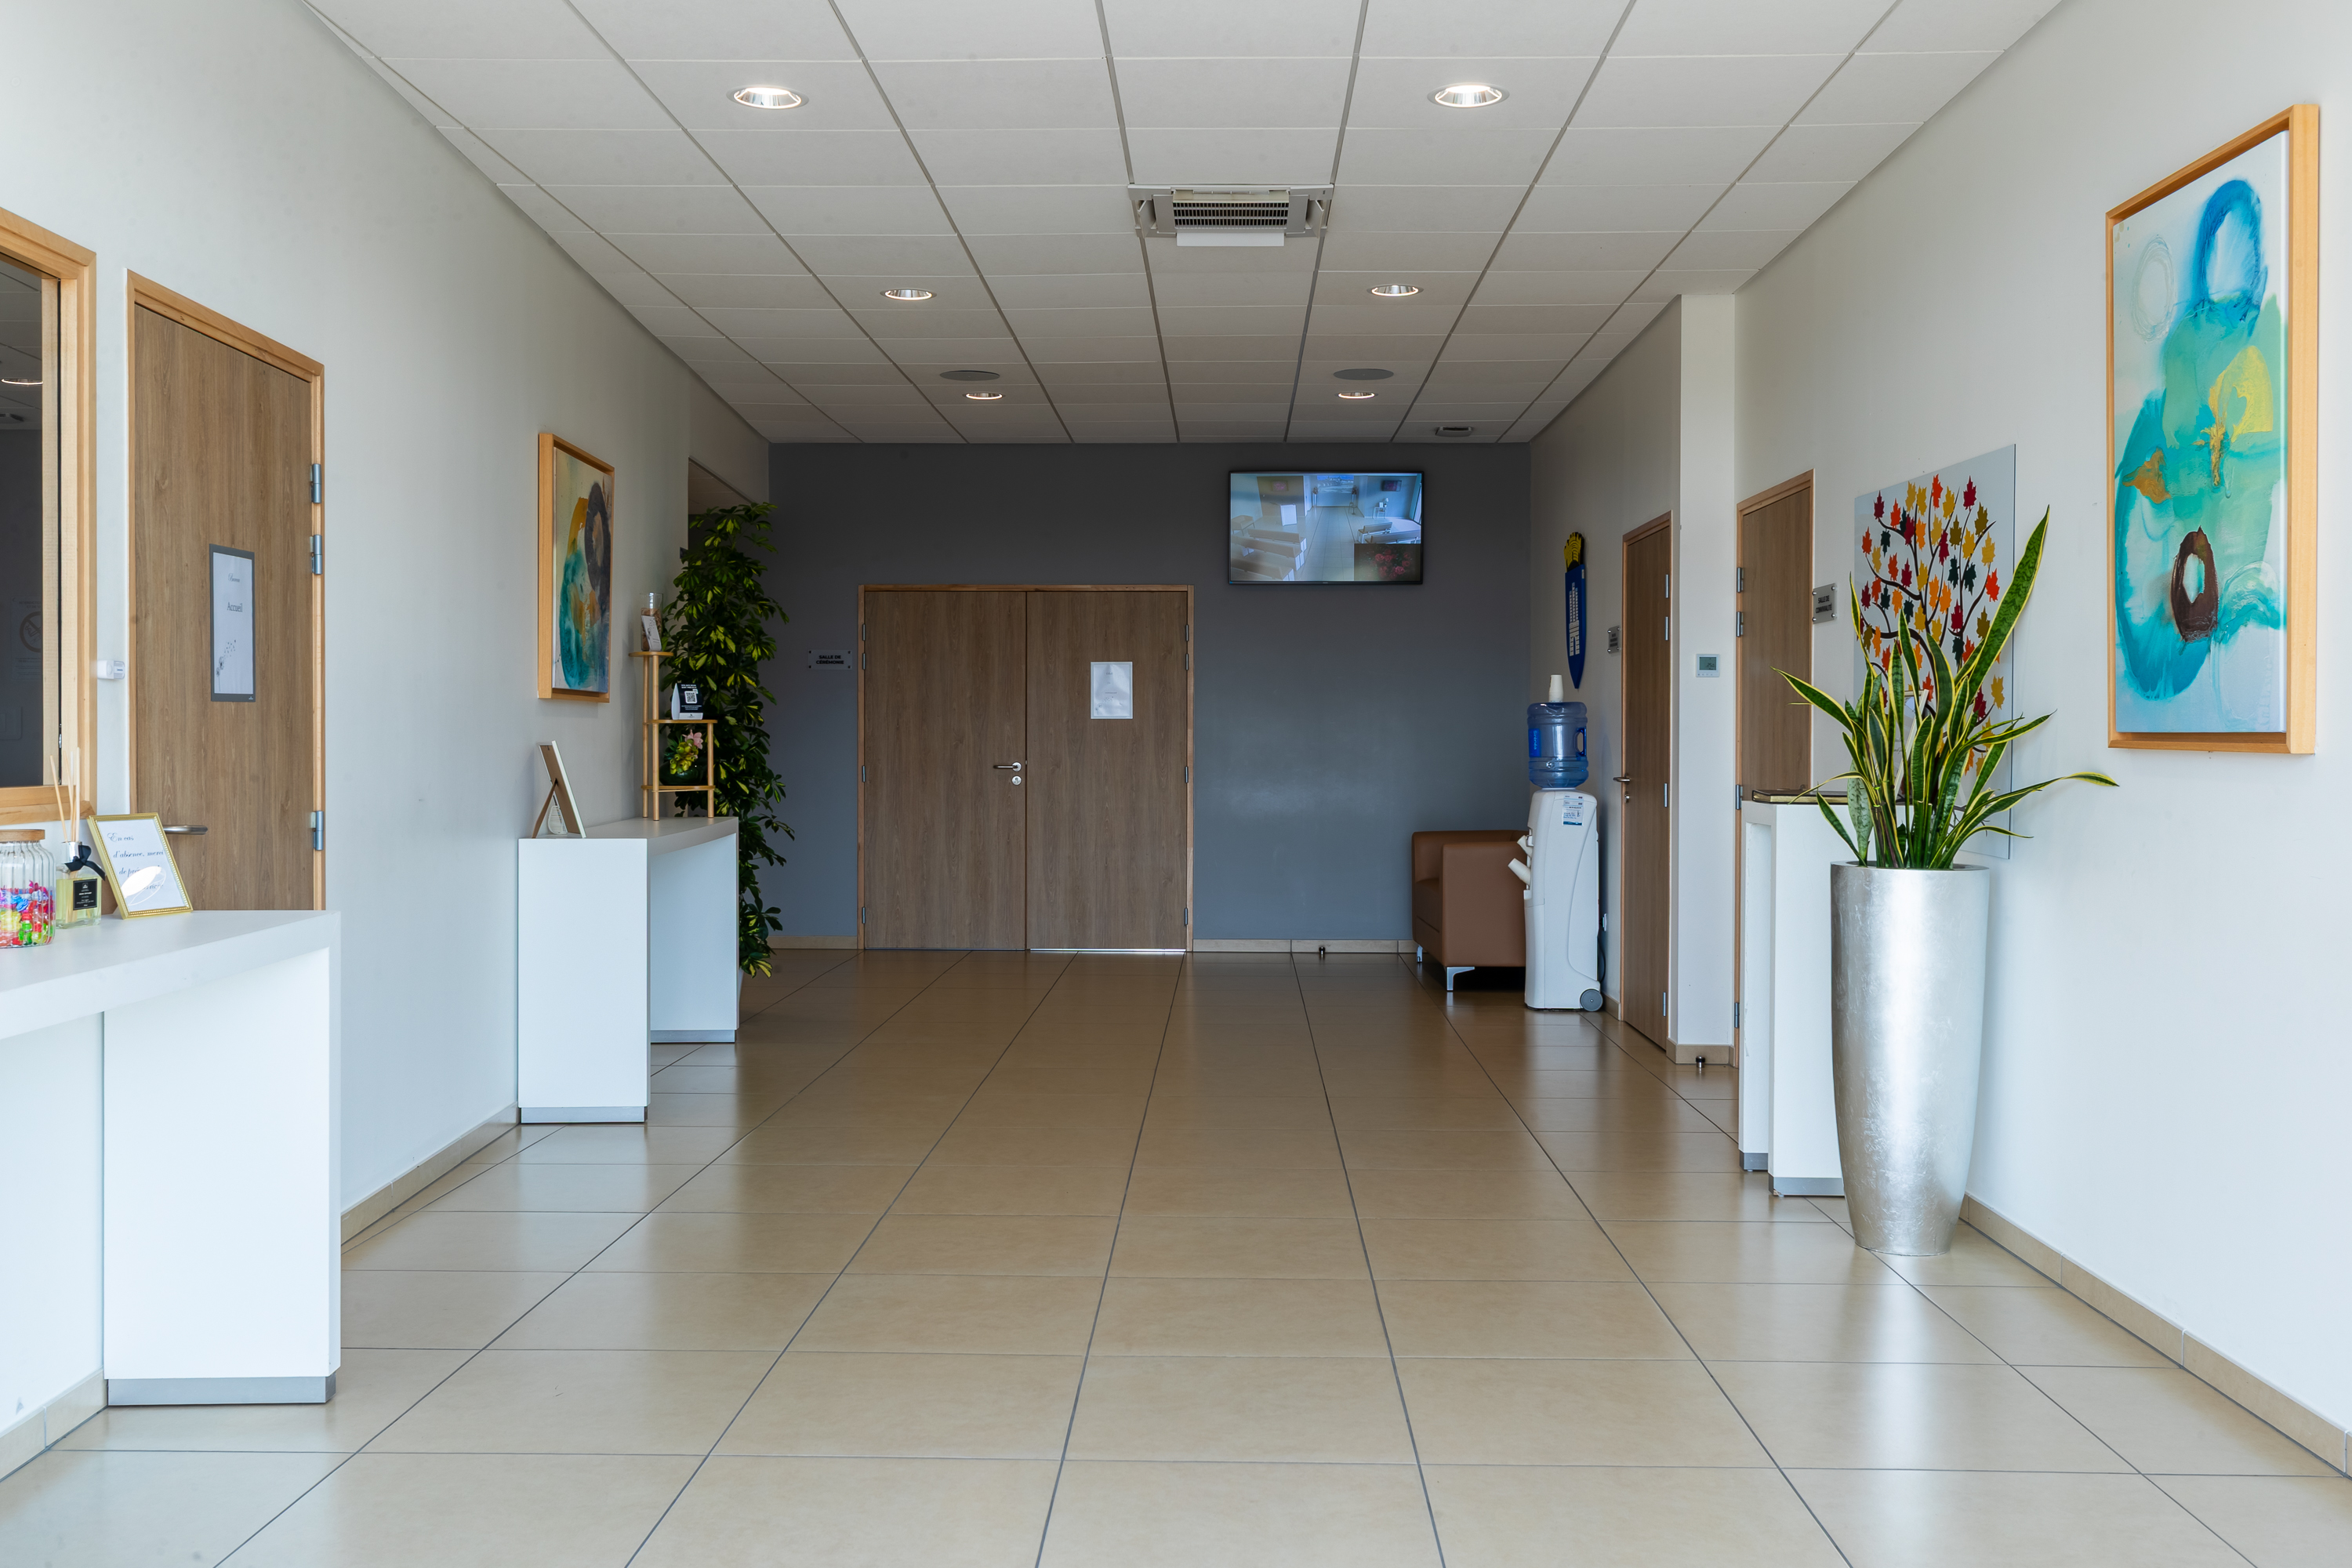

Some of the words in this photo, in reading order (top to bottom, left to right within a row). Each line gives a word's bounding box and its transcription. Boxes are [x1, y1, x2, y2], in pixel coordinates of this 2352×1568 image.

[227, 601, 243, 612] Accueil
[107, 833, 122, 842] En
[113, 850, 145, 858] d'absence,
[118, 867, 127, 876] de
